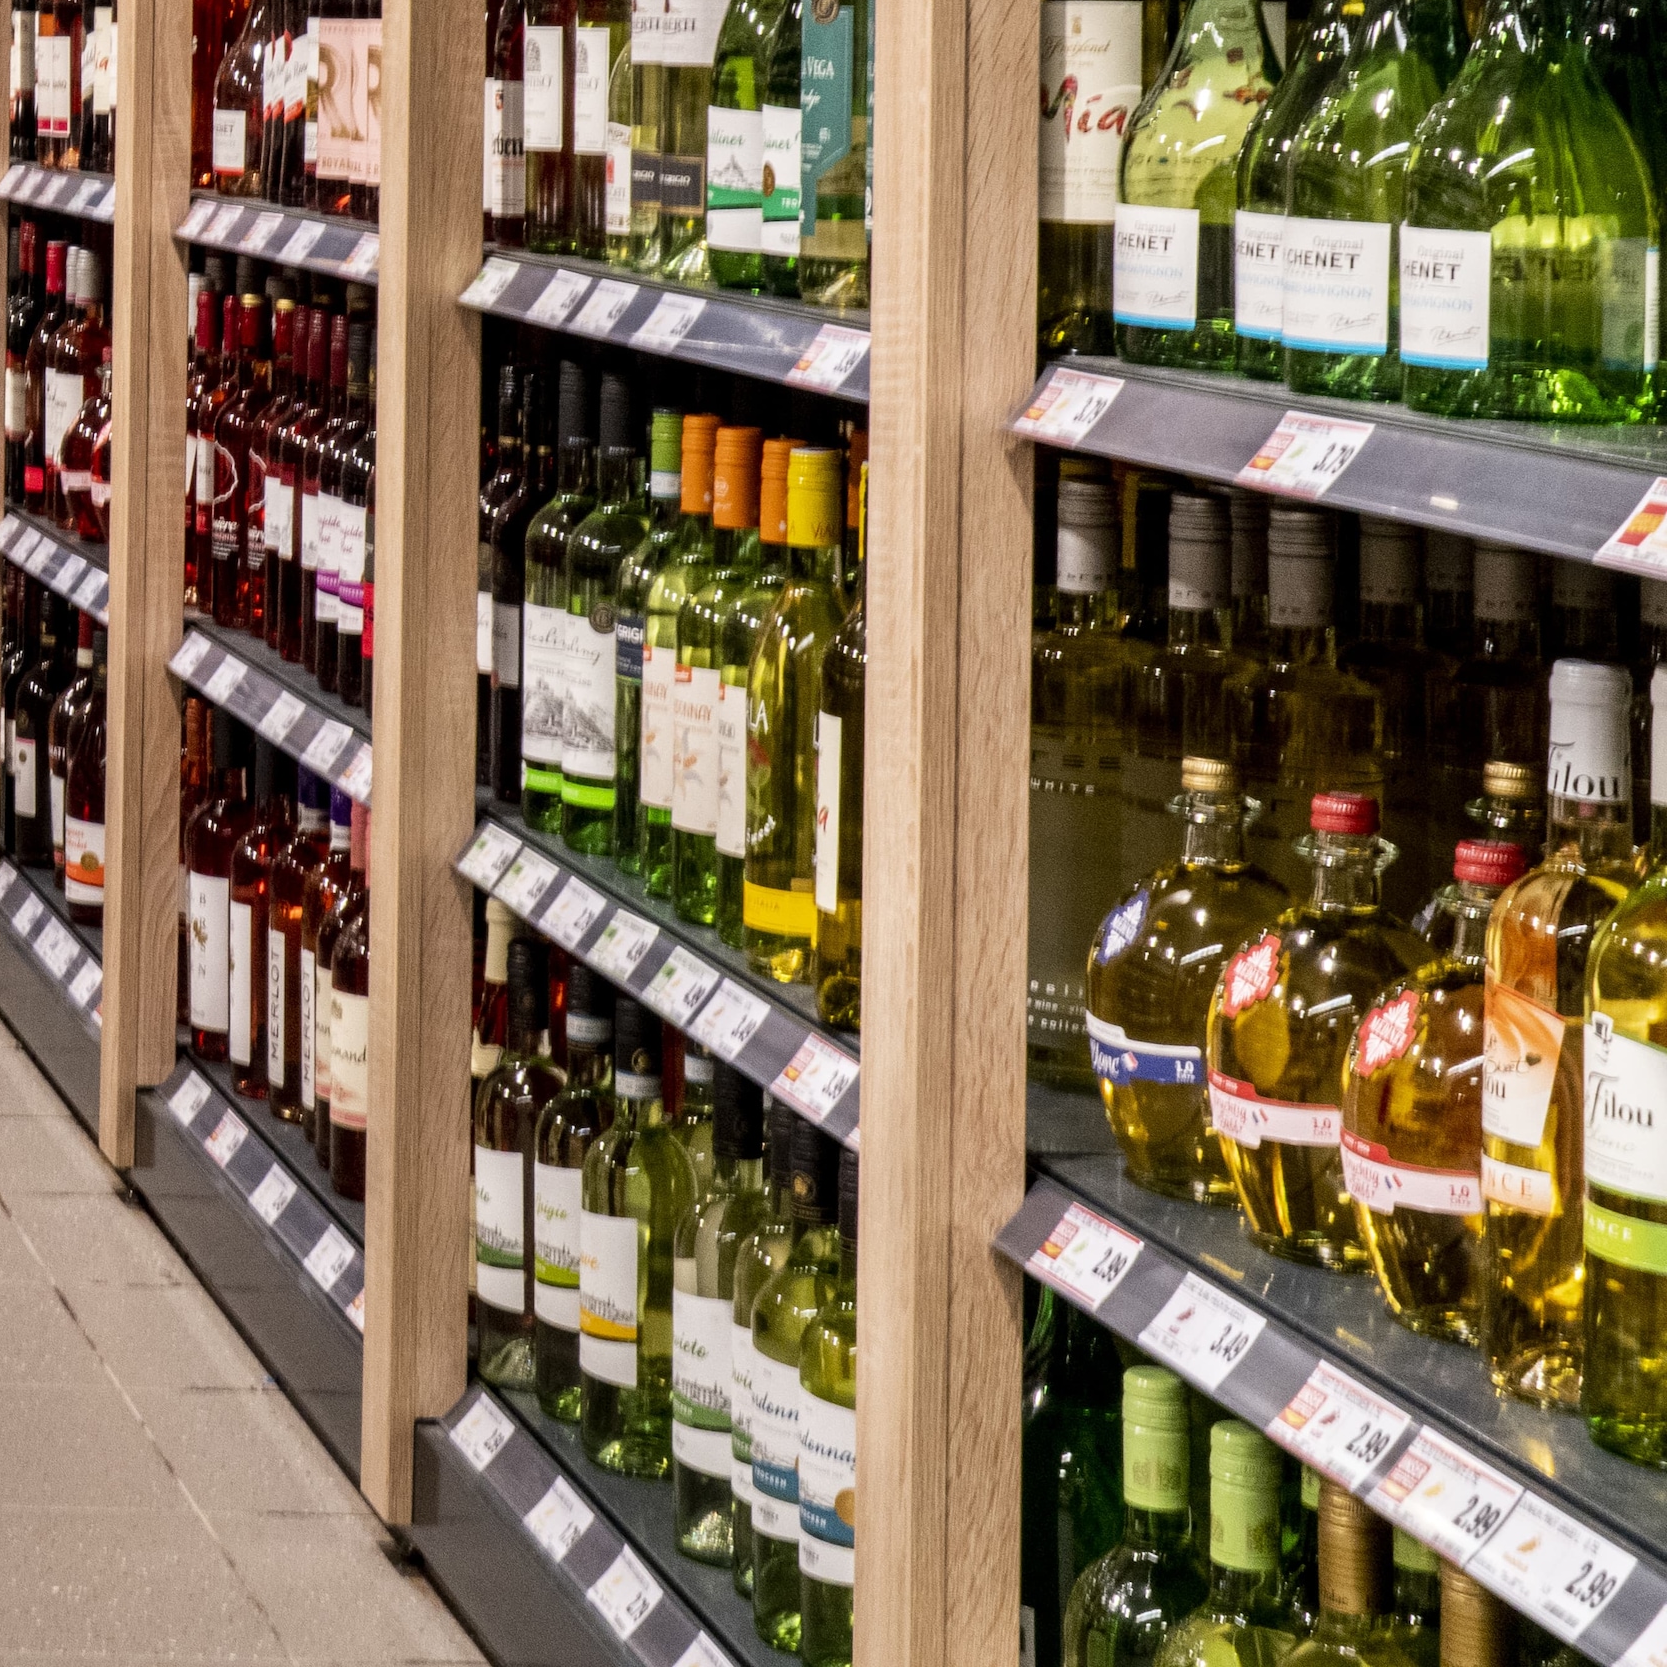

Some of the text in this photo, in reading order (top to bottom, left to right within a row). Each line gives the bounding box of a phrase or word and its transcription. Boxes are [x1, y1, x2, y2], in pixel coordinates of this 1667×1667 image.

[807, 57, 835, 79] VEGA
[1135, 221, 1176, 235] Original
[1312, 236, 1364, 250] Original
[1287, 251, 1360, 271] CHENET
[1417, 245, 1464, 260] Original
[1313, 442, 1354, 474] 3.79
[269, 948, 283, 1063] MERLOT
[1092, 1246, 1127, 1282] 2.99
[1210, 1324, 1249, 1362] 3.49
[1346, 1421, 1390, 1464] 2.99
[1452, 1494, 1500, 1538] 2.99
[1565, 1559, 1617, 1609] 2.99
